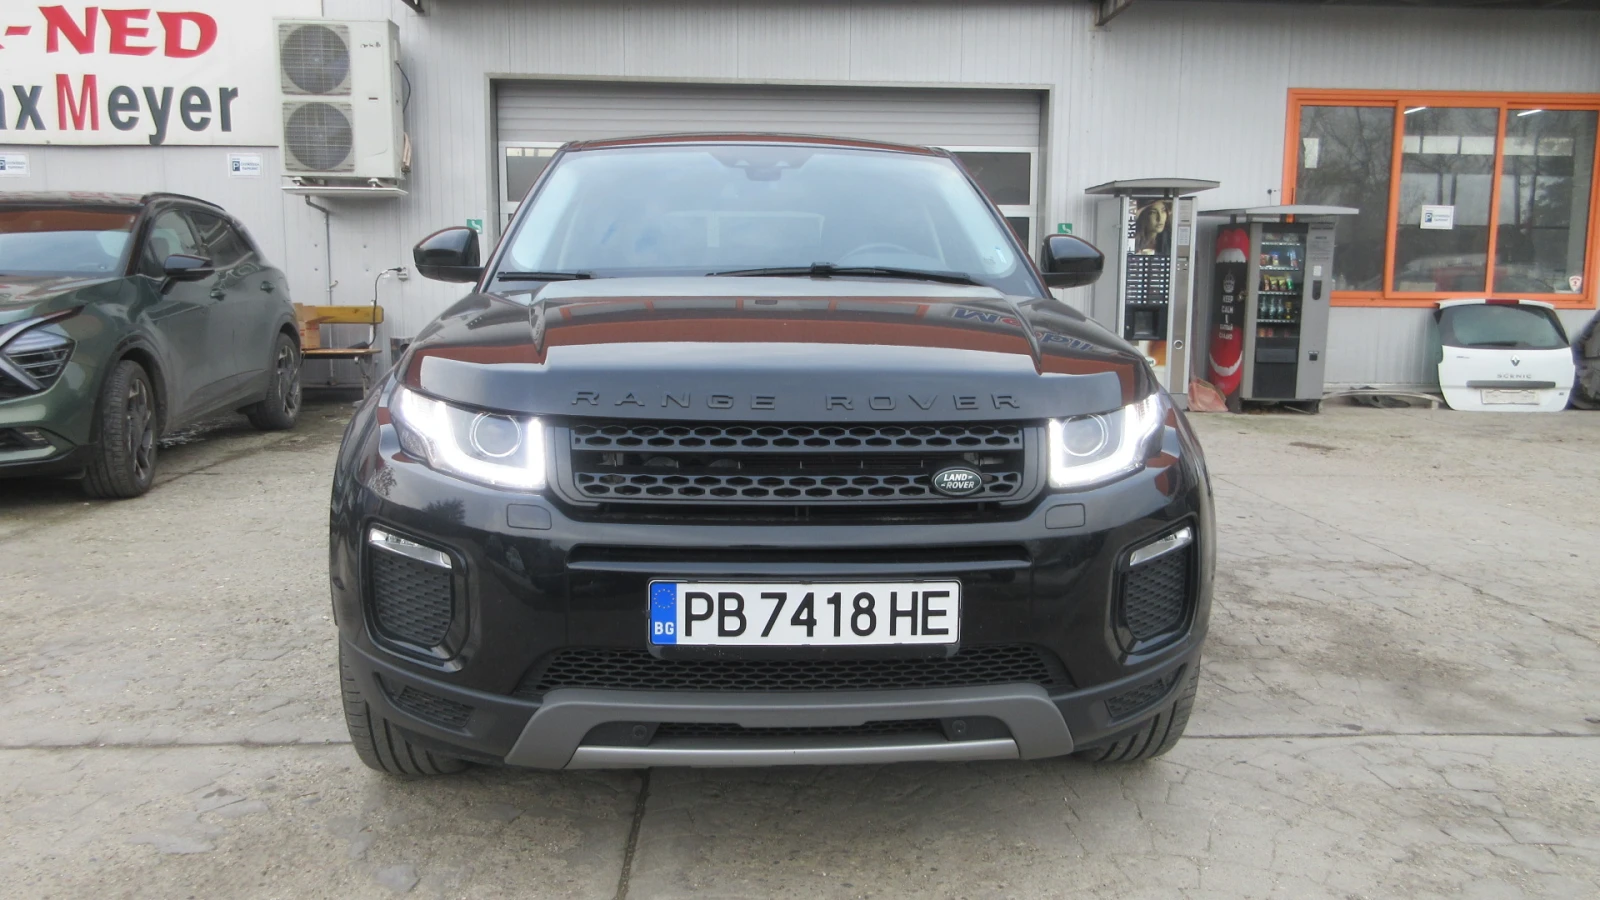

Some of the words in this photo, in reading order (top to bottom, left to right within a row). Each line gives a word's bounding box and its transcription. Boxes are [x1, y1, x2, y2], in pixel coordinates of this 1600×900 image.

[0, 5, 218, 58] -NED
[233, 161, 240, 171] P
[570, 391, 776, 410] RANGE
[825, 393, 1021, 411] ROVER
[943, 473, 968, 481] LAND
[945, 481, 975, 489] ROVER
[654, 621, 675, 635] BG
[684, 591, 747, 637] PB
[760, 591, 877, 637] 7418
[889, 590, 950, 636] HE
